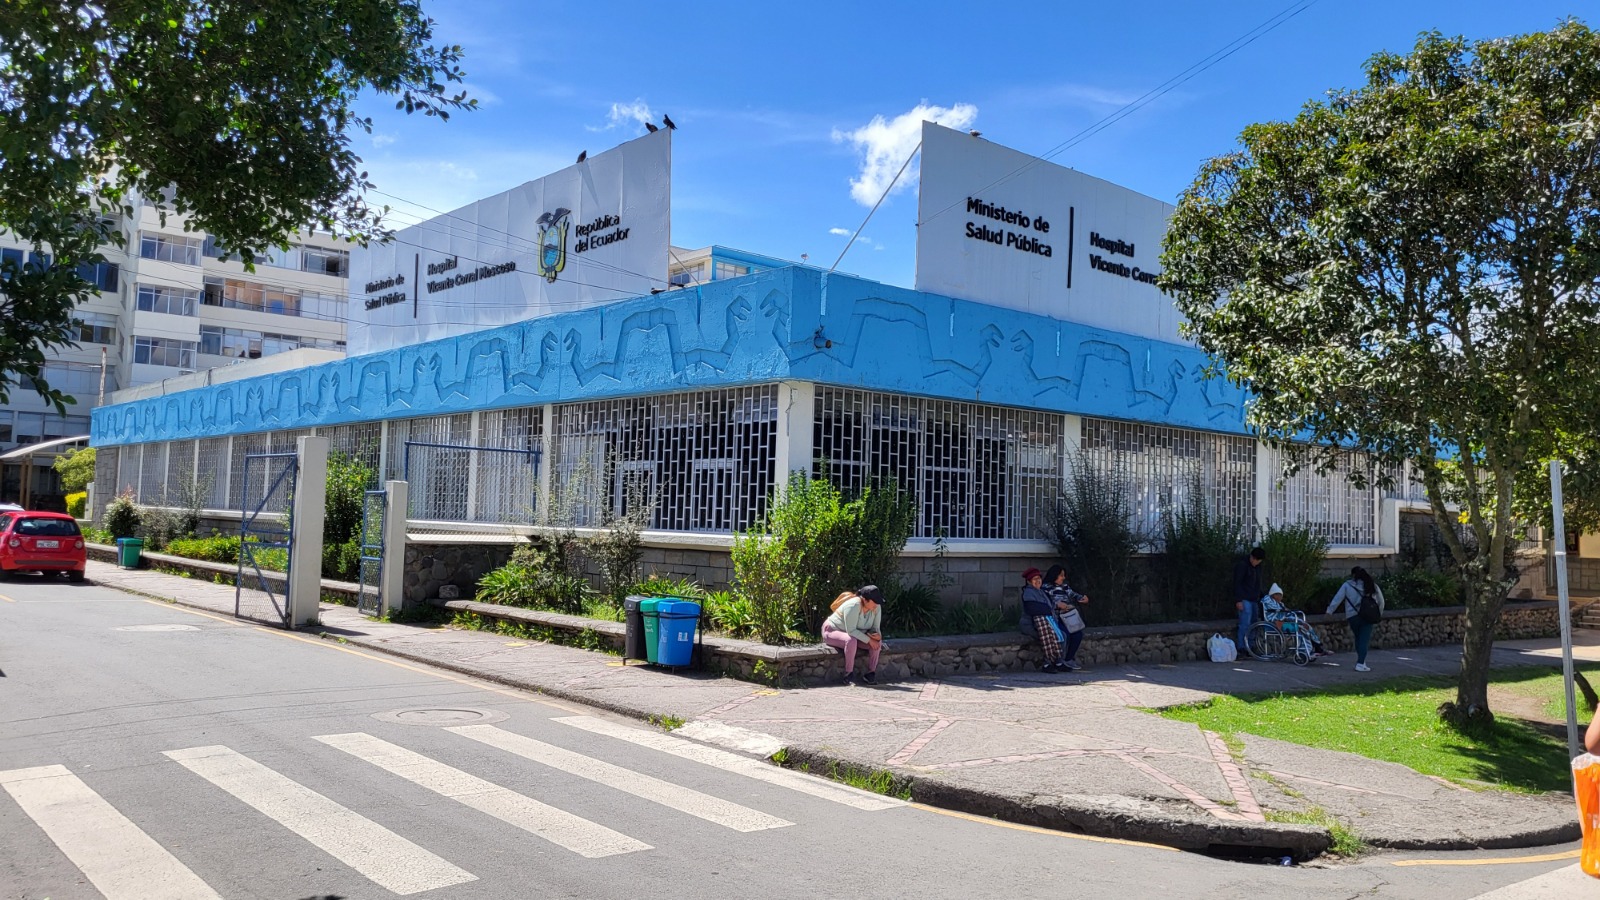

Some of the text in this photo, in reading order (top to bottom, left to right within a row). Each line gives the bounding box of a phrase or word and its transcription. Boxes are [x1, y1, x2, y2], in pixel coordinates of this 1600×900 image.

[576, 215, 620, 237] República
[967, 197, 1050, 233] Ministerio de
[575, 227, 630, 253] del Ecuador
[966, 222, 1052, 257] Salud Pública
[1090, 231, 1135, 257] Hospital
[427, 256, 458, 276] Hospital
[427, 261, 516, 295] Vicente Corral Moscoso
[1090, 254, 1131, 278] Vicente
[365, 273, 405, 294] Ministerio de
[365, 292, 406, 311] Salud Pública
